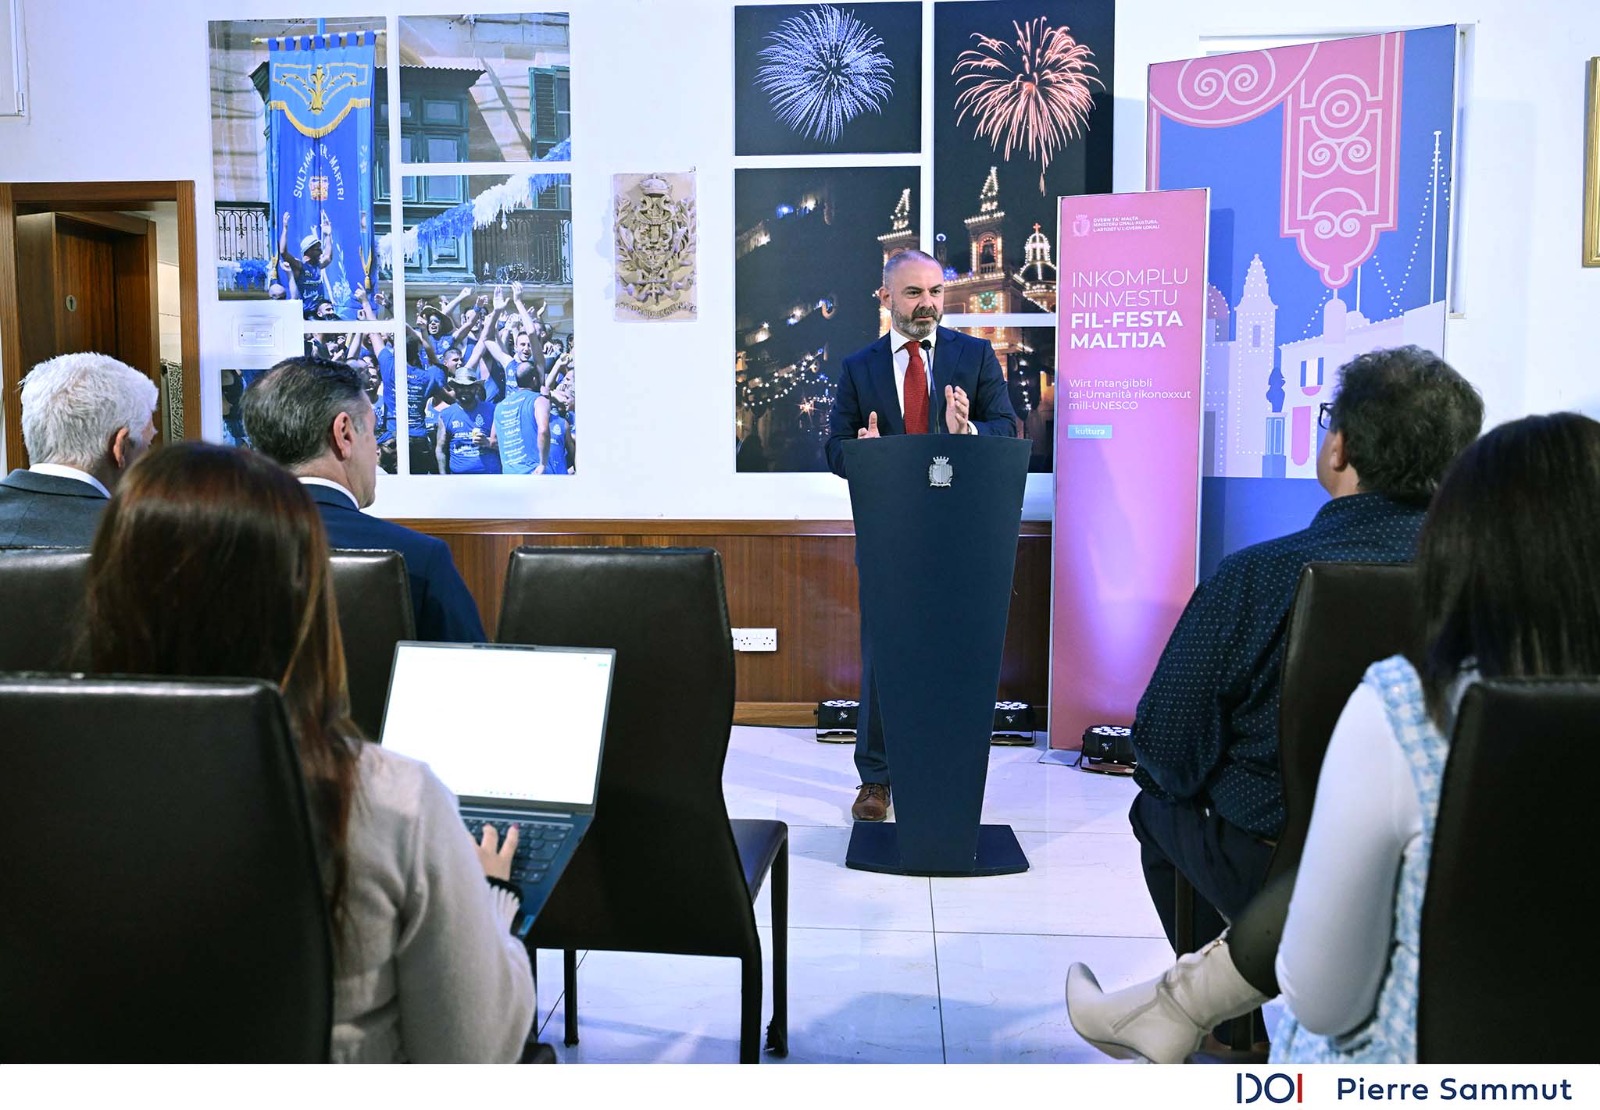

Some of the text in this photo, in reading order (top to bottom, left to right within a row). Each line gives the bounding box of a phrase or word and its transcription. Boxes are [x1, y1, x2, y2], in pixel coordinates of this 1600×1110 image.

[293, 147, 316, 198] SULTANA
[1072, 267, 1189, 288] INKOMPLU
[1072, 289, 1178, 308] NINVESTU
[1071, 310, 1184, 329] FIL-FESTA
[1070, 331, 1167, 350] MALTIJA
[1069, 378, 1092, 388] Wirt
[1068, 389, 1192, 400] tal-Umanità rikonoxxut
[1068, 400, 1139, 410] mill-UNESCO
[1075, 427, 1106, 436] kultura
